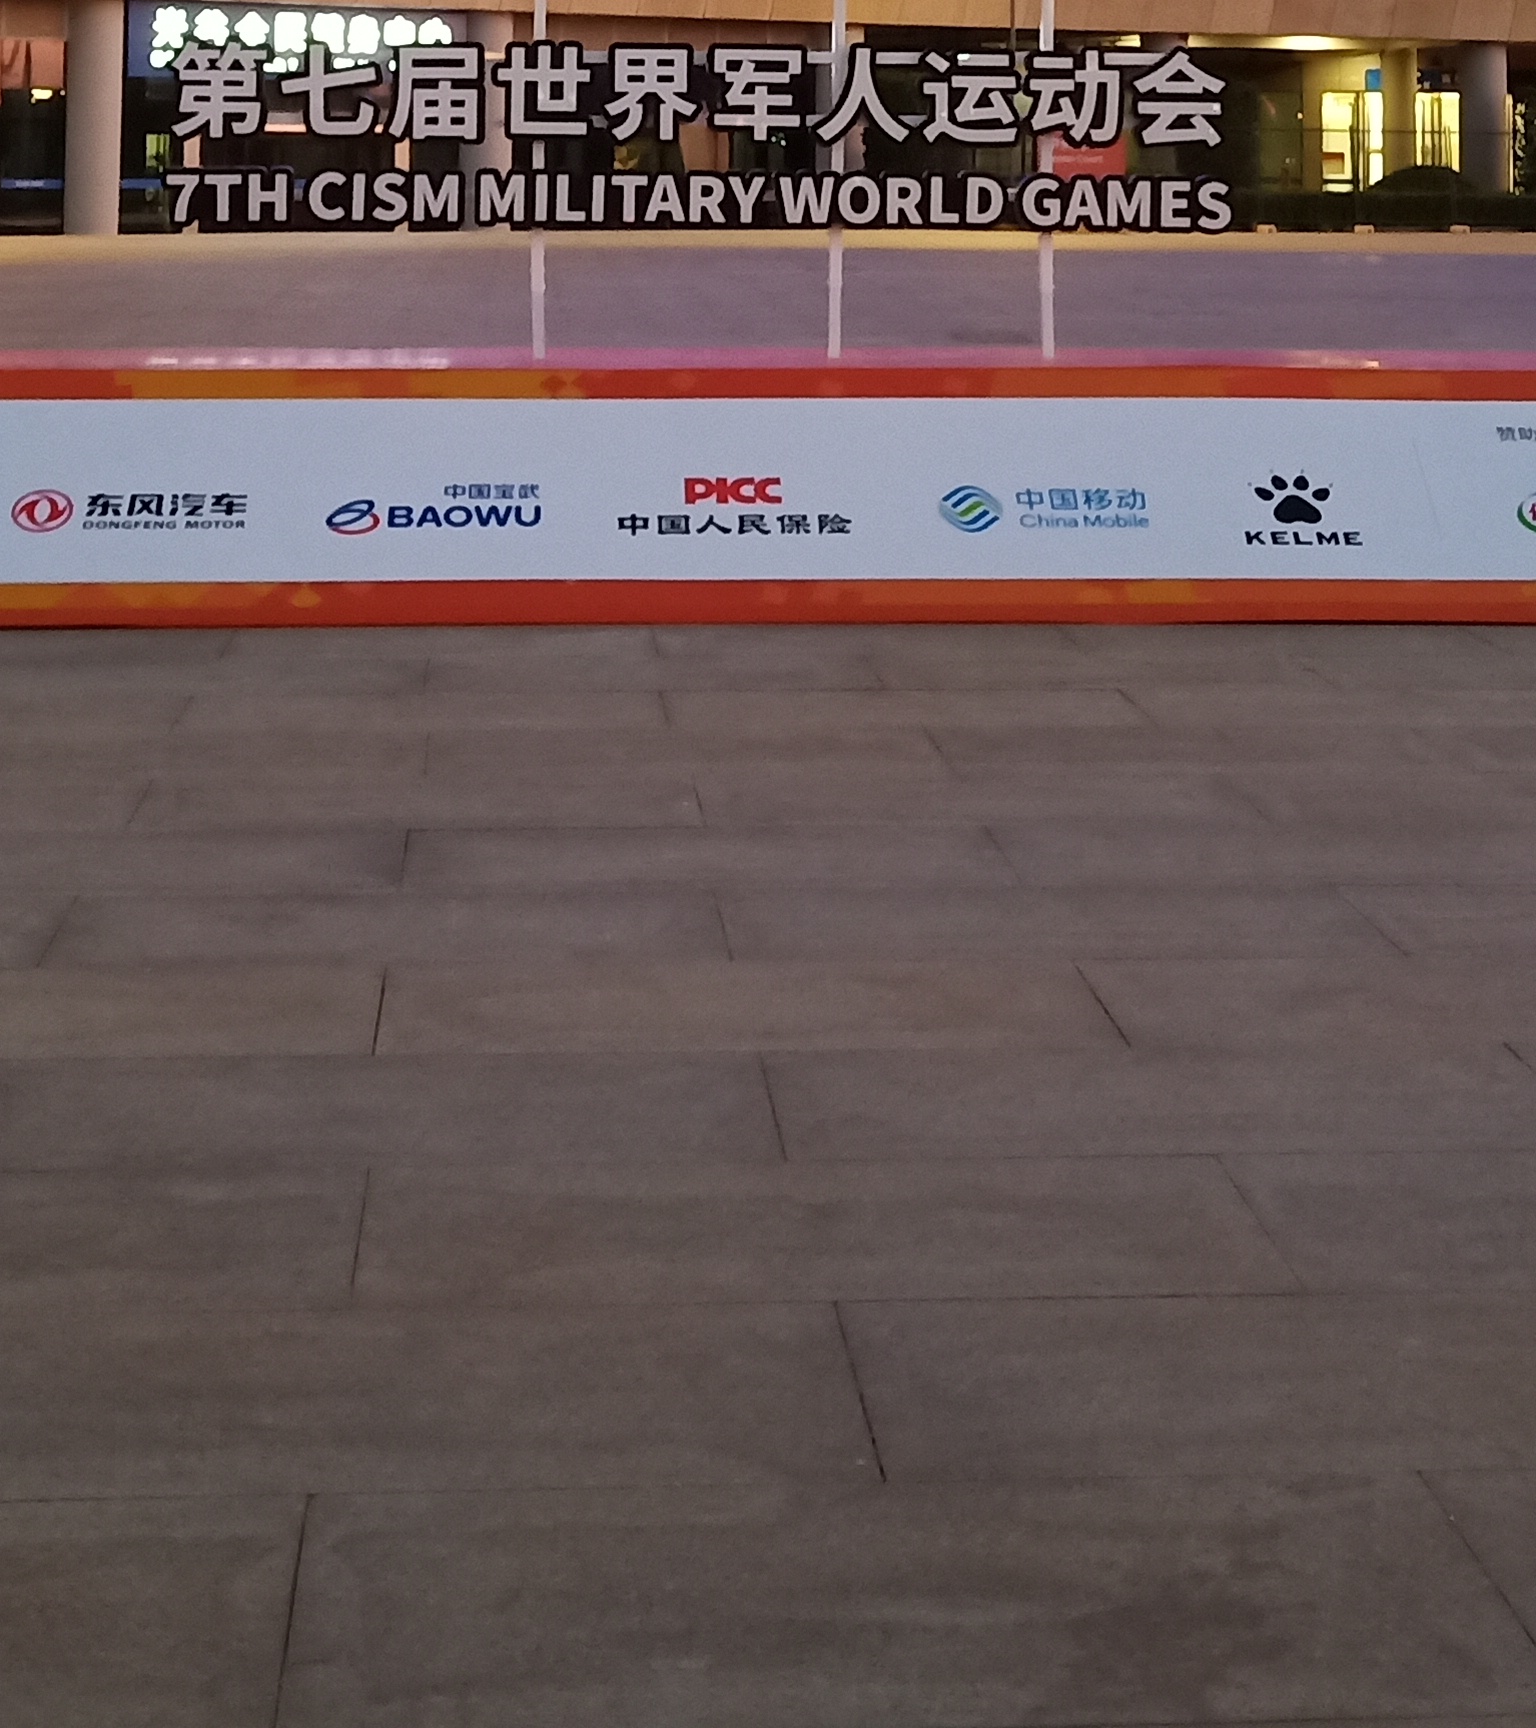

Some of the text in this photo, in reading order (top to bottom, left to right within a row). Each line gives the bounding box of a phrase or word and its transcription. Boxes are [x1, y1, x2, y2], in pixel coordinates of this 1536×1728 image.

[172, 43, 1226, 147] 第七届世界军人运动会
[166, 174, 1232, 229] 7TH CISM MILITARY WORLD GAMES
[684, 476, 782, 504] PICC
[1016, 488, 1146, 510] 中国移动
[86, 493, 248, 516] 东风汽车
[83, 519, 246, 530] DONGFENG MOTOR
[387, 505, 541, 528] BAOWU
[618, 514, 852, 536] 中国人民保险
[1019, 514, 1149, 528] China Mobile
[1245, 530, 1363, 546] KELME
